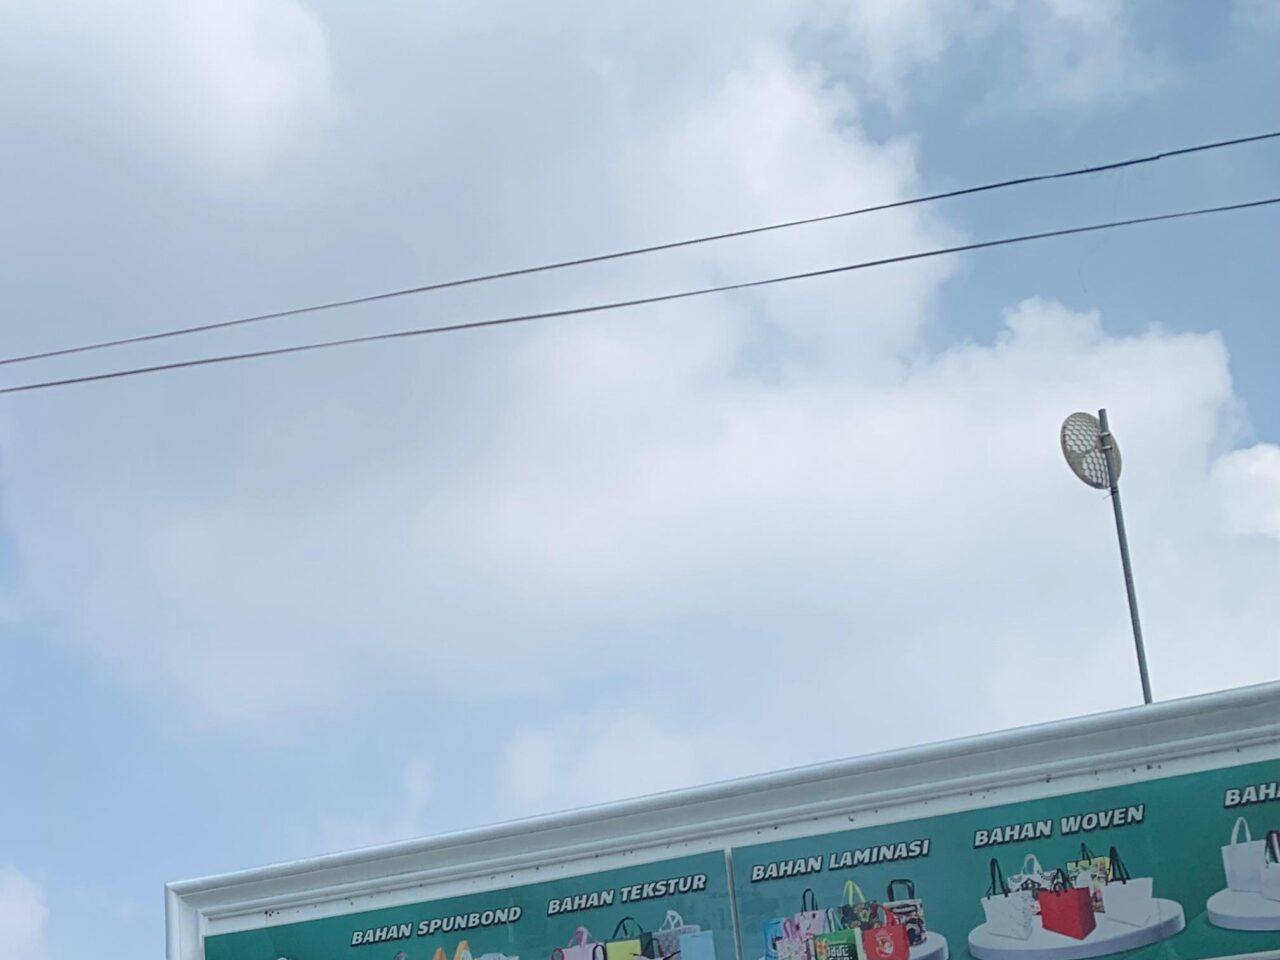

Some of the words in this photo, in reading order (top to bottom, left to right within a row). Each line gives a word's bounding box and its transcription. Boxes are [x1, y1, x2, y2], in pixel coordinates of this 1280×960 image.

[1224, 782, 1280, 806] BAH
[974, 819, 1052, 847] BAHAN
[1060, 804, 1144, 835] WOVEN
[751, 856, 822, 882] BAHAN
[829, 839, 930, 870] LAMINASI
[548, 889, 614, 915] BAHAN
[621, 874, 707, 902] TEKSTUR
[351, 922, 412, 946] BAHAN
[417, 906, 522, 936] SPUNBOND
